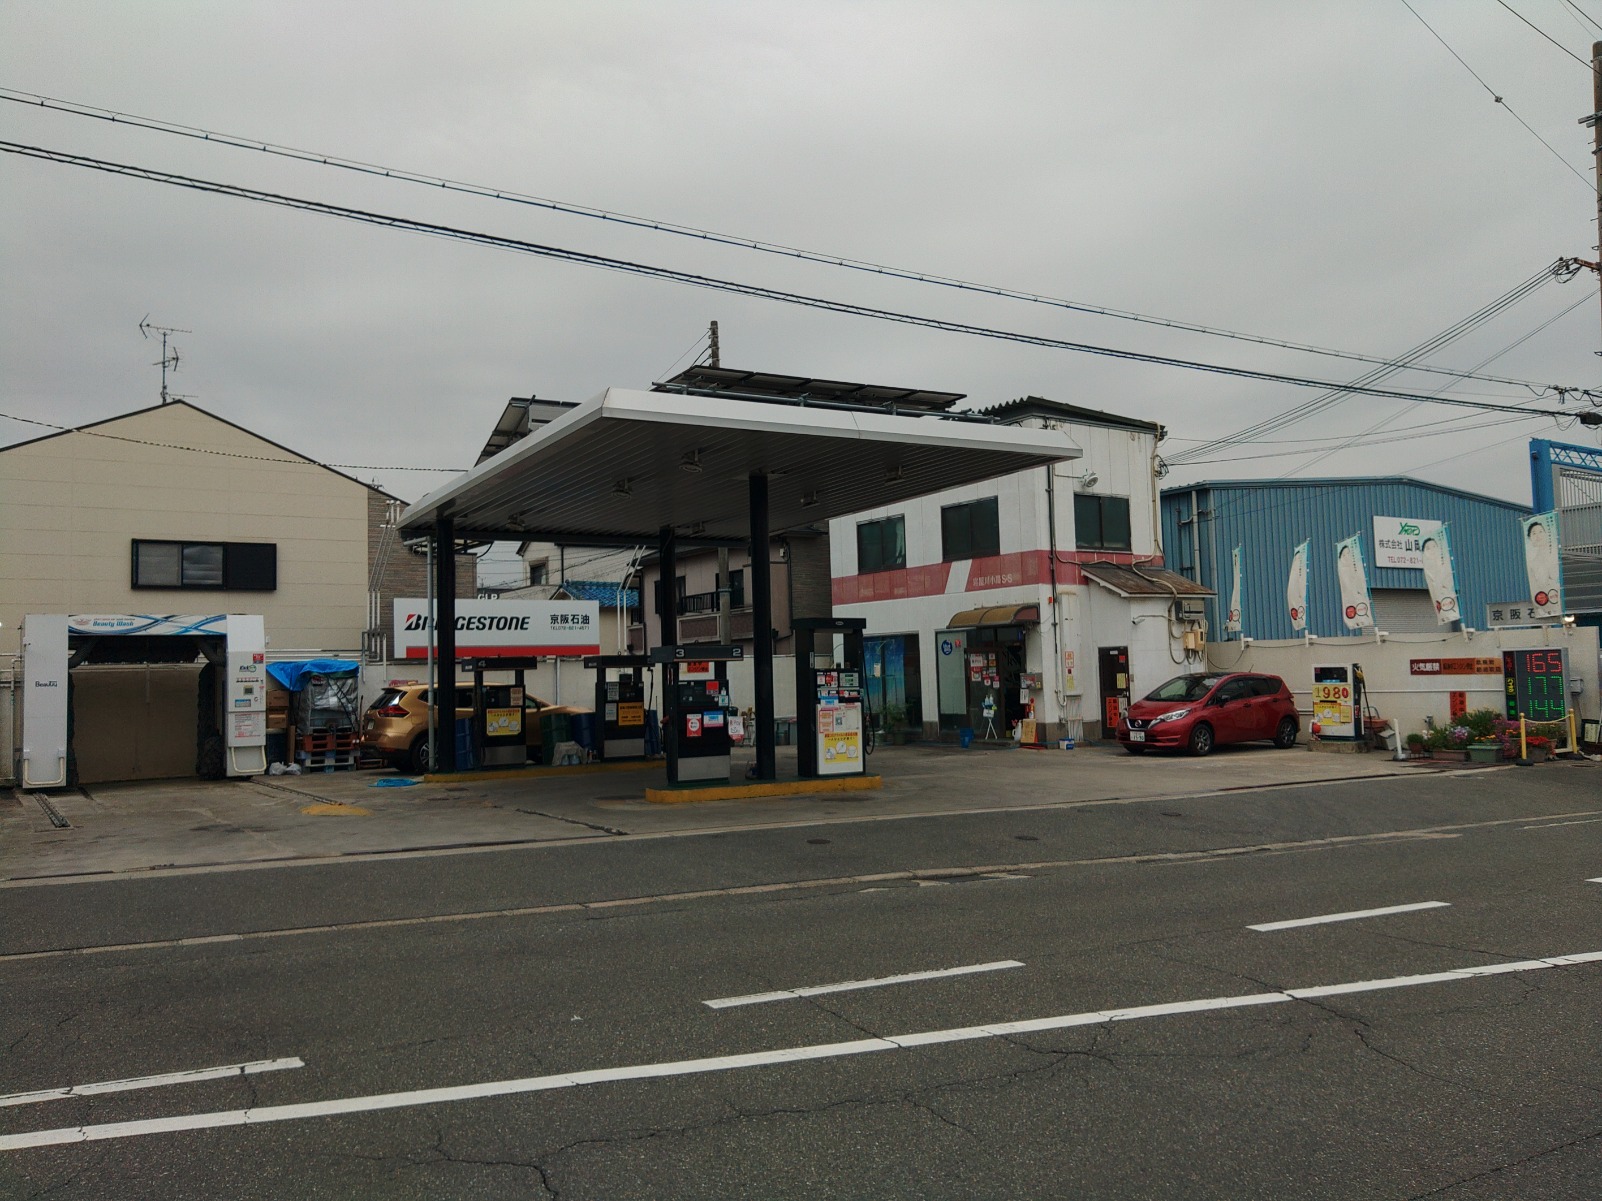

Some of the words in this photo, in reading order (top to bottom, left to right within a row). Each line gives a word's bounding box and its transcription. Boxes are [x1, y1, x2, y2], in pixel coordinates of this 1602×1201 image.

[549, 613, 590, 625] 京阪石油
[676, 649, 684, 657] 3
[733, 649, 741, 657] 2
[478, 660, 486, 668] 4
[1526, 652, 1562, 673] 165
[1528, 675, 1563, 695] 177
[1530, 699, 1564, 718] 144
